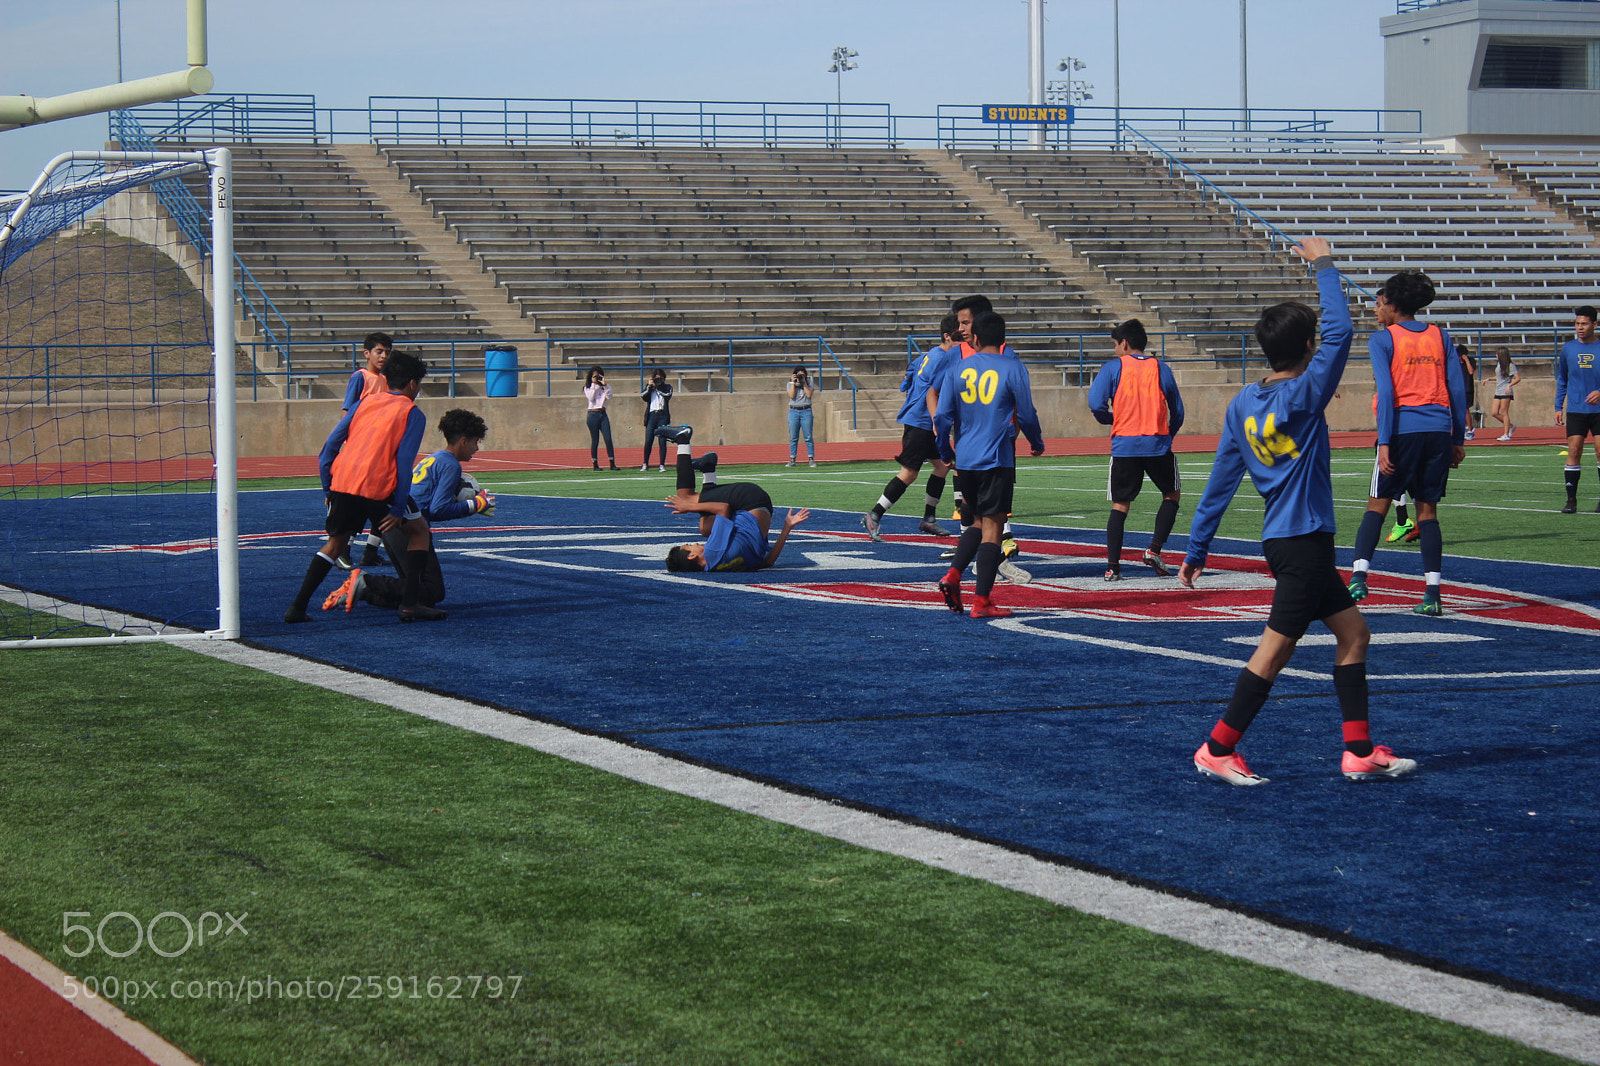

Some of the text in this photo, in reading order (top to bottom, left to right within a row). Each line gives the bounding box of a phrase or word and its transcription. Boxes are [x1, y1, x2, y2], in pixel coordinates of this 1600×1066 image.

[988, 107, 1067, 121] STUDENTS
[217, 176, 226, 209] PEVO
[1578, 353, 1595, 365] P
[960, 367, 999, 405] 30
[1244, 412, 1301, 467] 64
